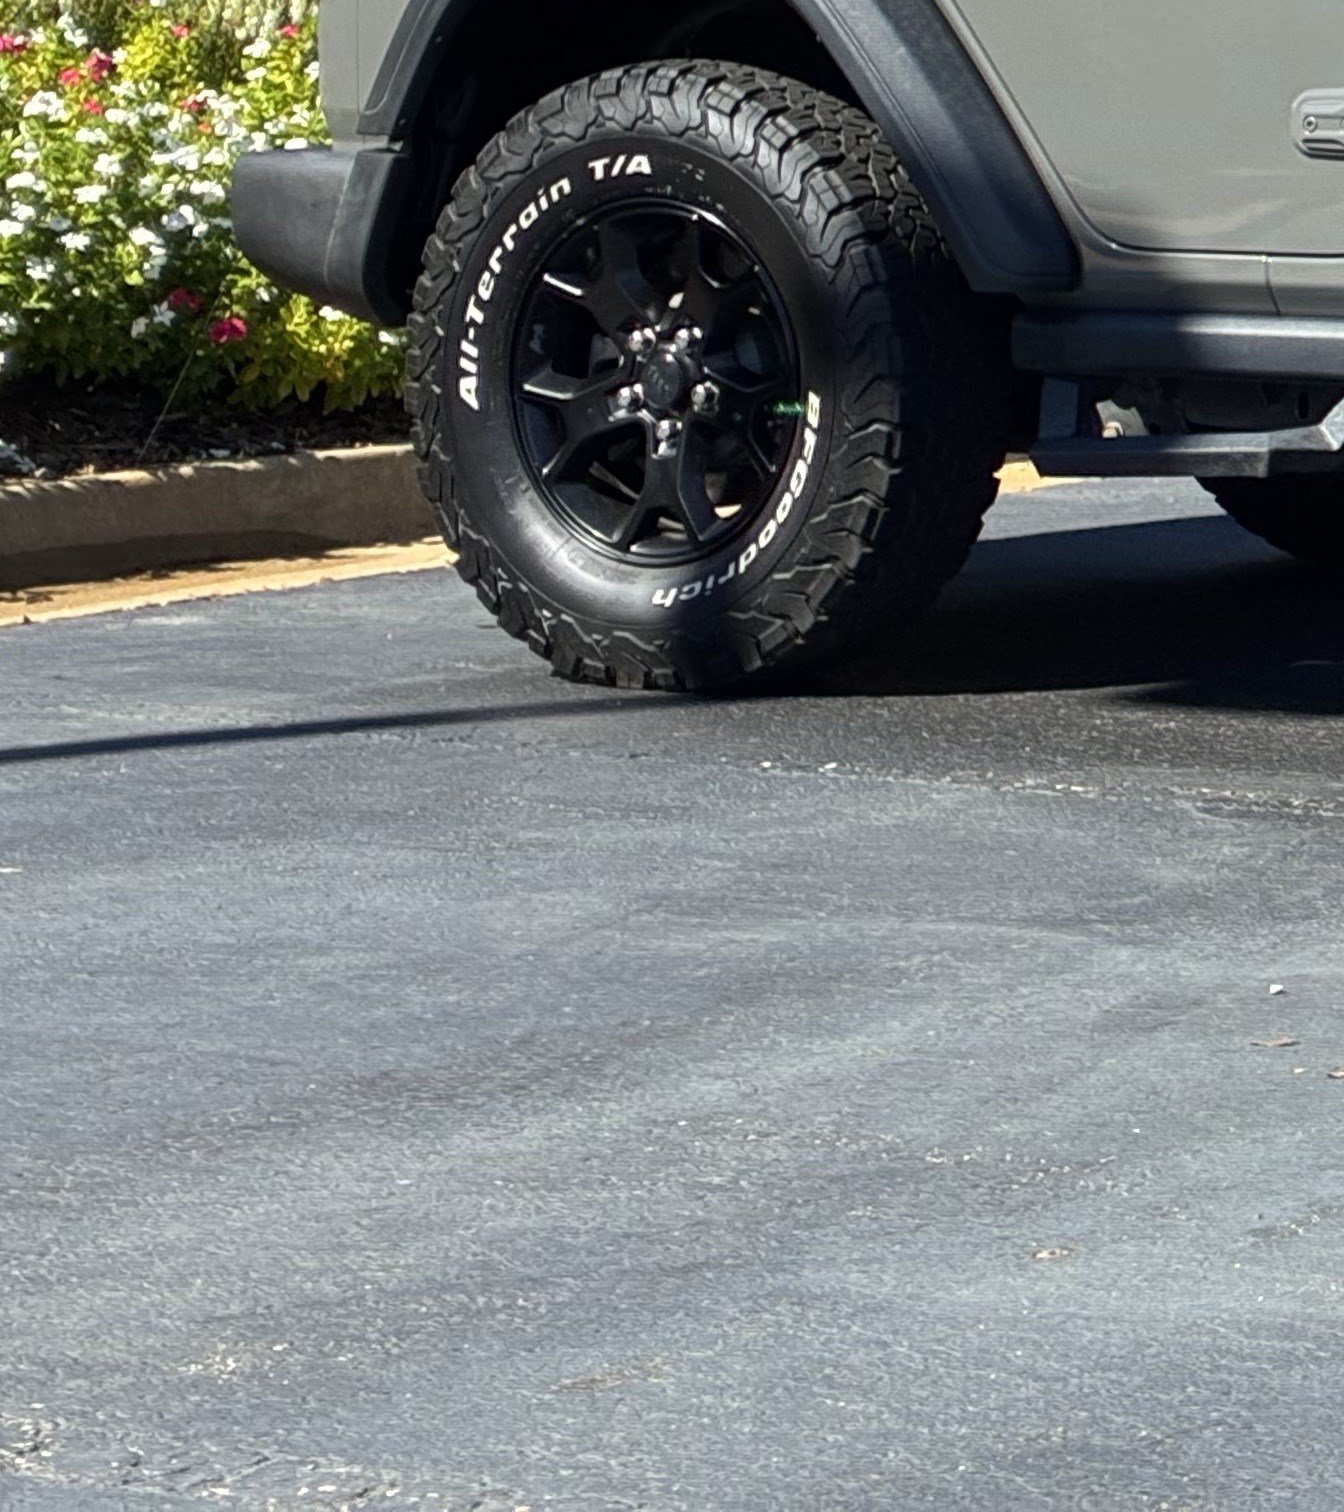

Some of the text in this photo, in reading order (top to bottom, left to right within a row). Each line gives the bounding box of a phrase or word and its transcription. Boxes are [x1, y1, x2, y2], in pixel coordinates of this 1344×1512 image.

[459, 154, 652, 411] All-Terrain T/A
[651, 390, 822, 608] BFGoodrich
